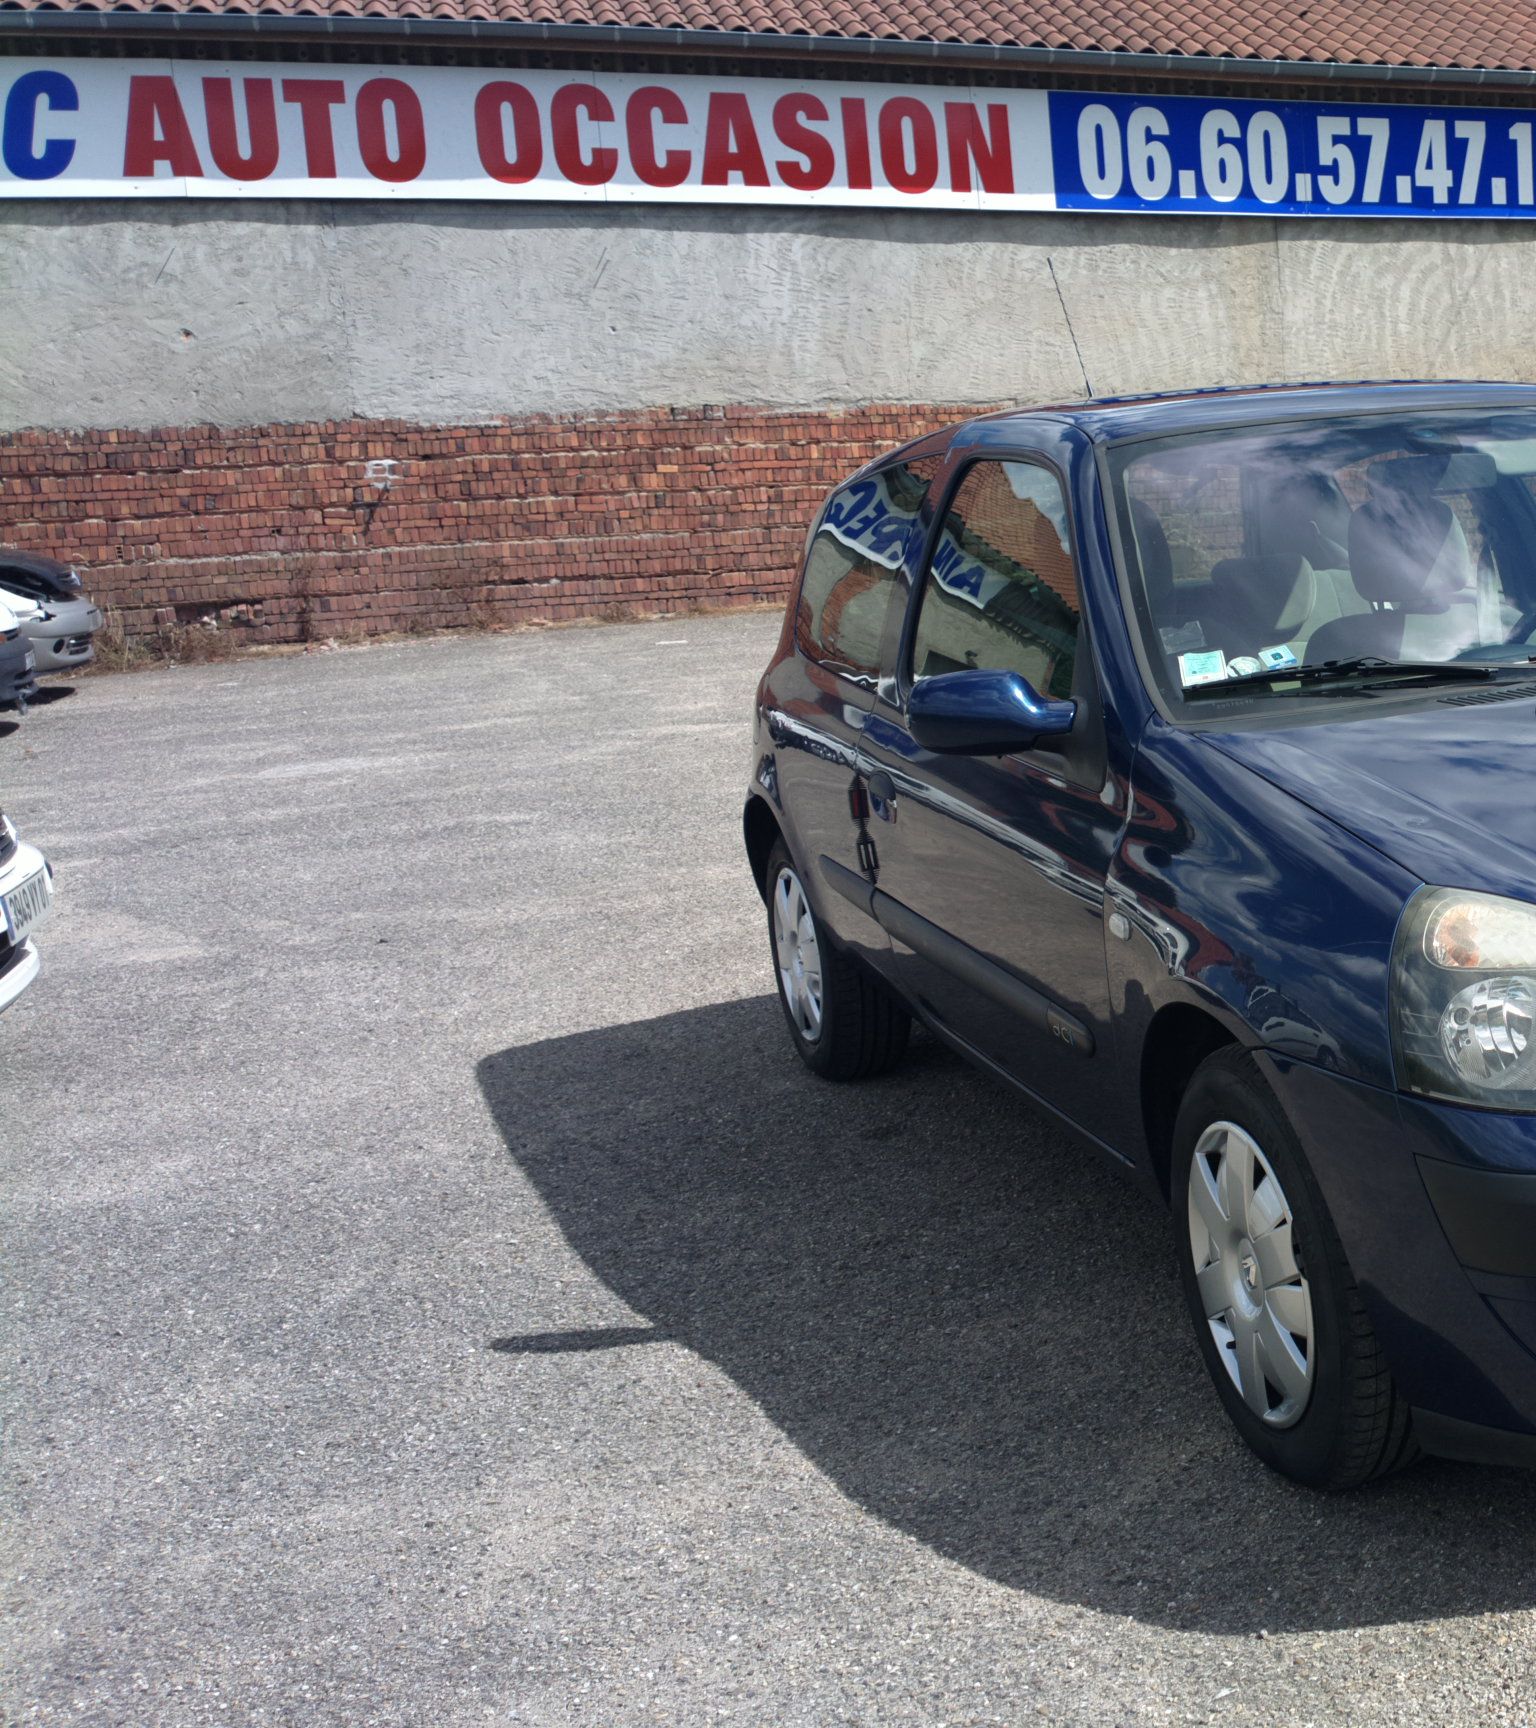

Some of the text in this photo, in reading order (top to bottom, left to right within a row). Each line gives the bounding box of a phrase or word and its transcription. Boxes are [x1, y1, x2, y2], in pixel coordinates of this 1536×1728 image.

[2, 70, 1015, 195] C AUTO OCCASION
